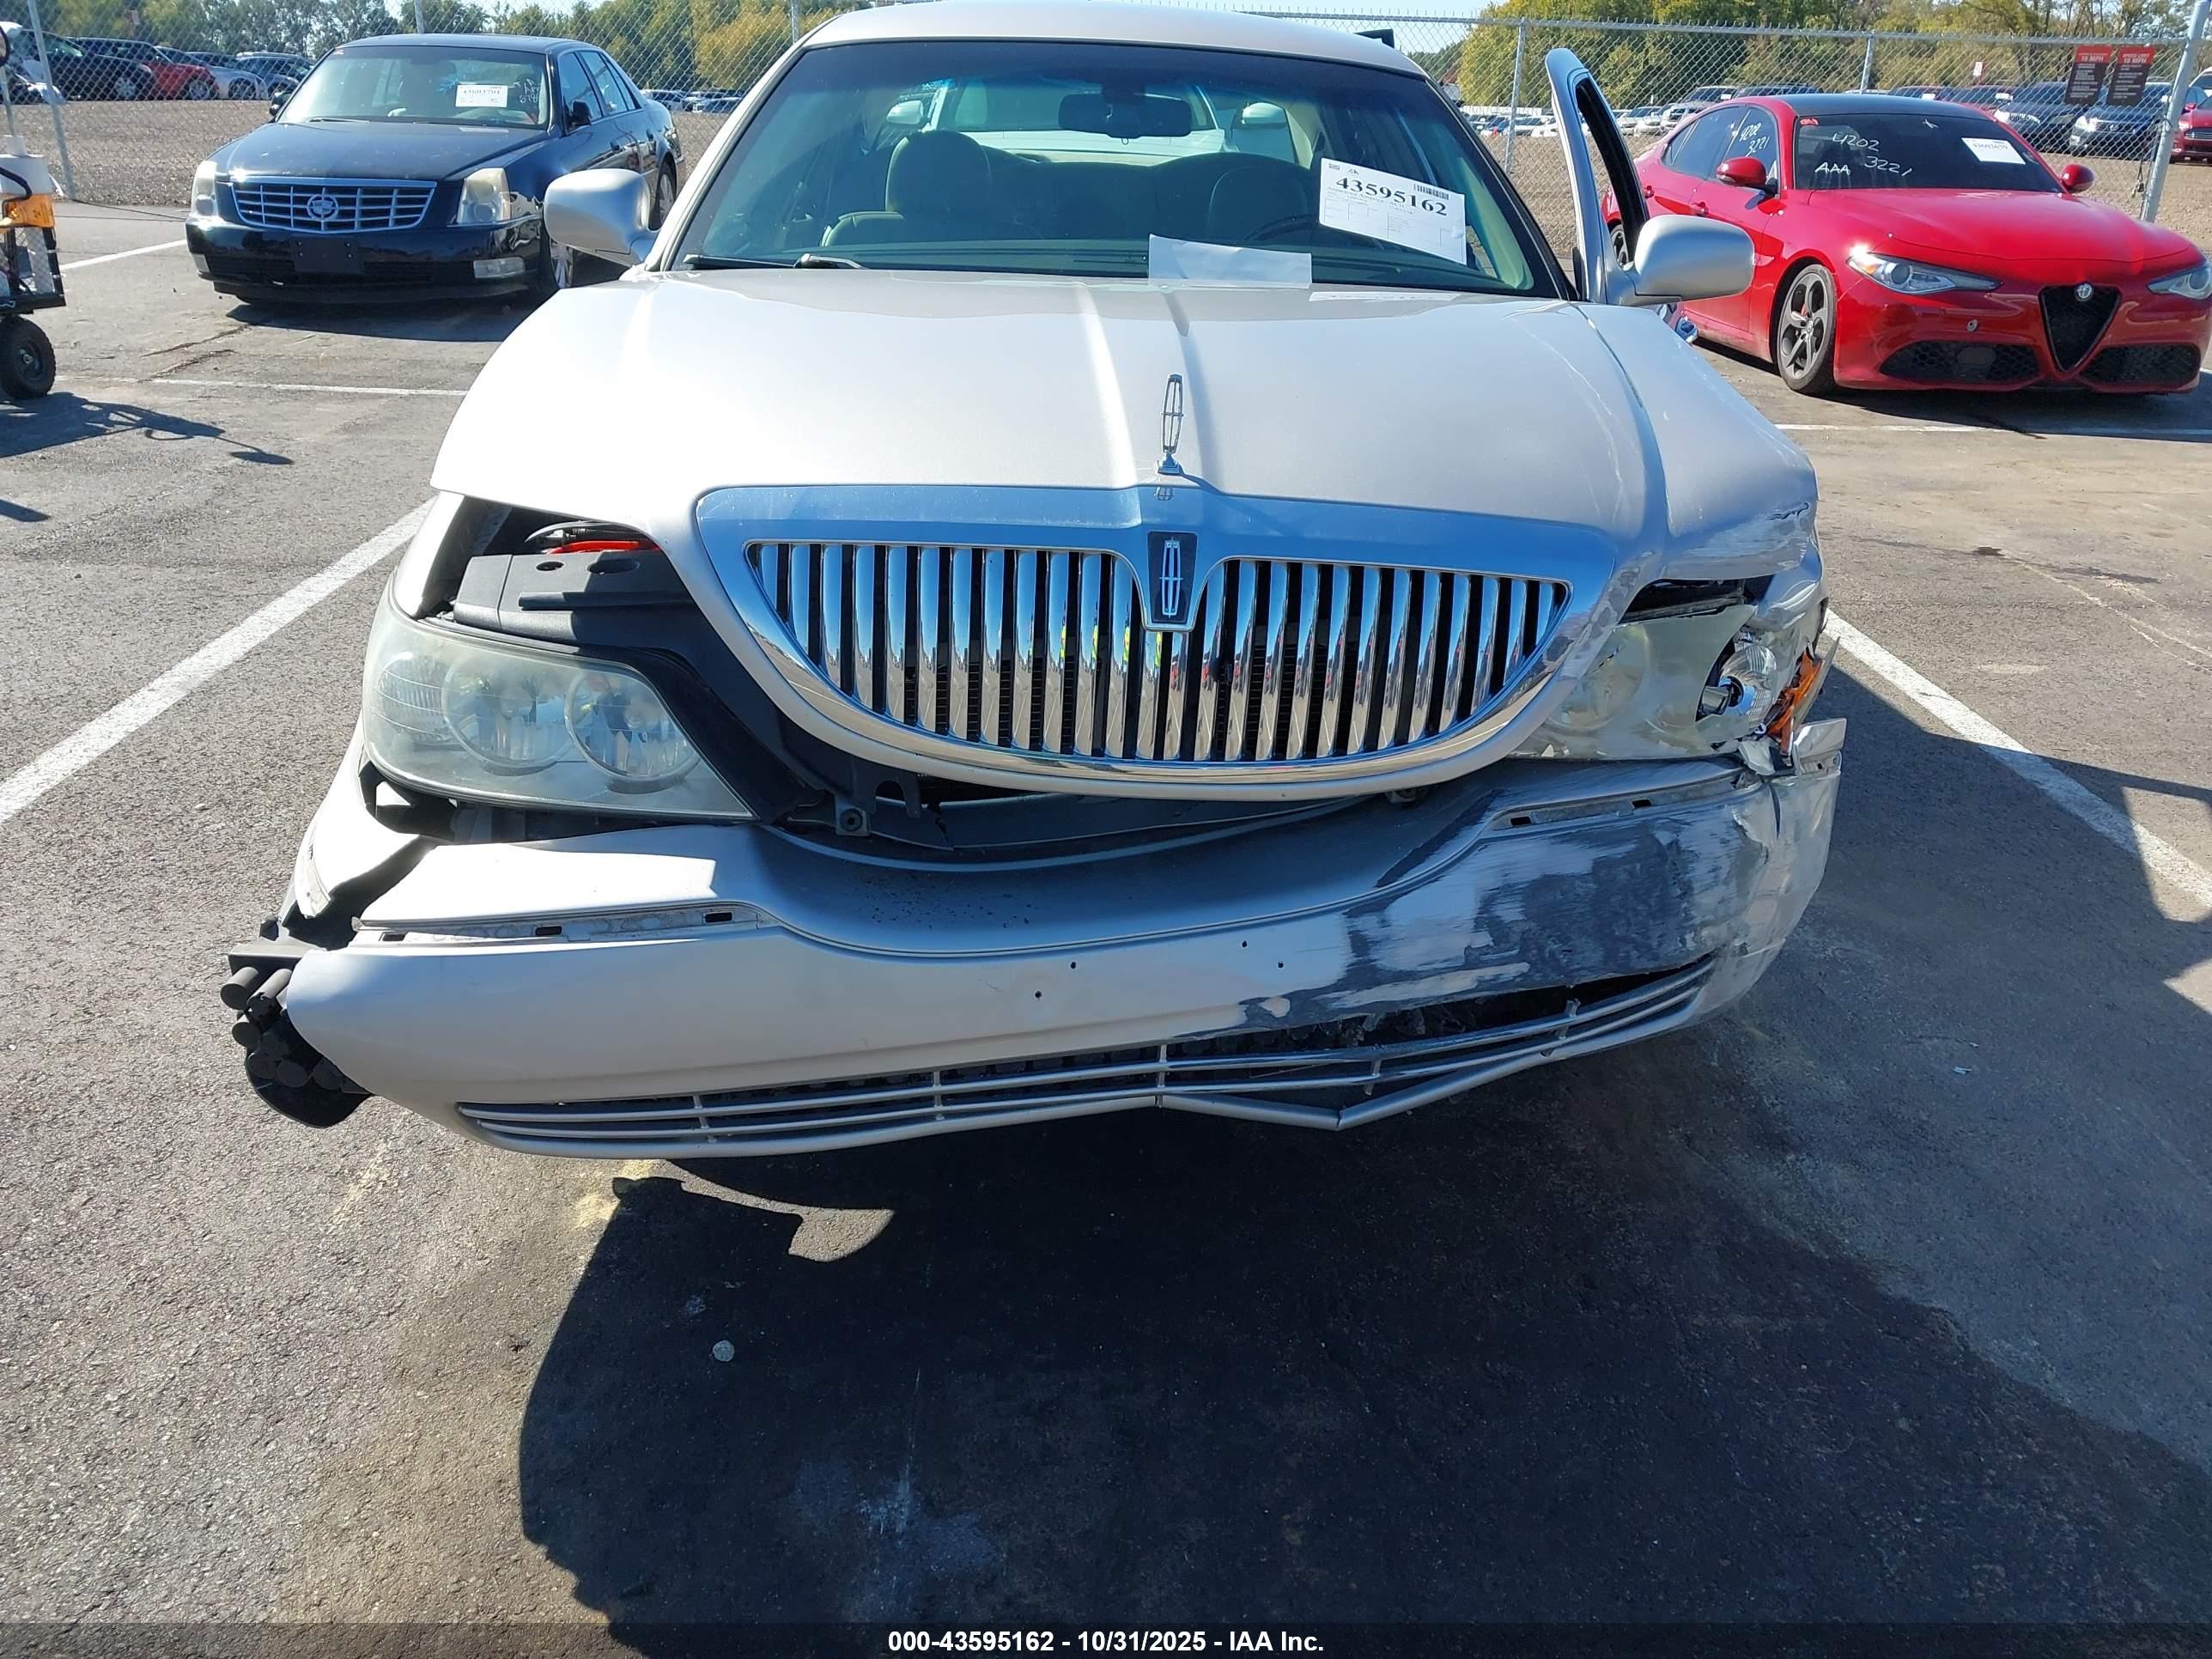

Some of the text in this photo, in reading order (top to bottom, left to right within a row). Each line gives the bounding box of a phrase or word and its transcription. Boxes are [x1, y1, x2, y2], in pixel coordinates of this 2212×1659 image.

[1832, 132, 1880, 152] 4202
[1814, 161, 1850, 175] AAA
[1863, 155, 1913, 177] 3221
[1336, 177, 1448, 216] 43595162
